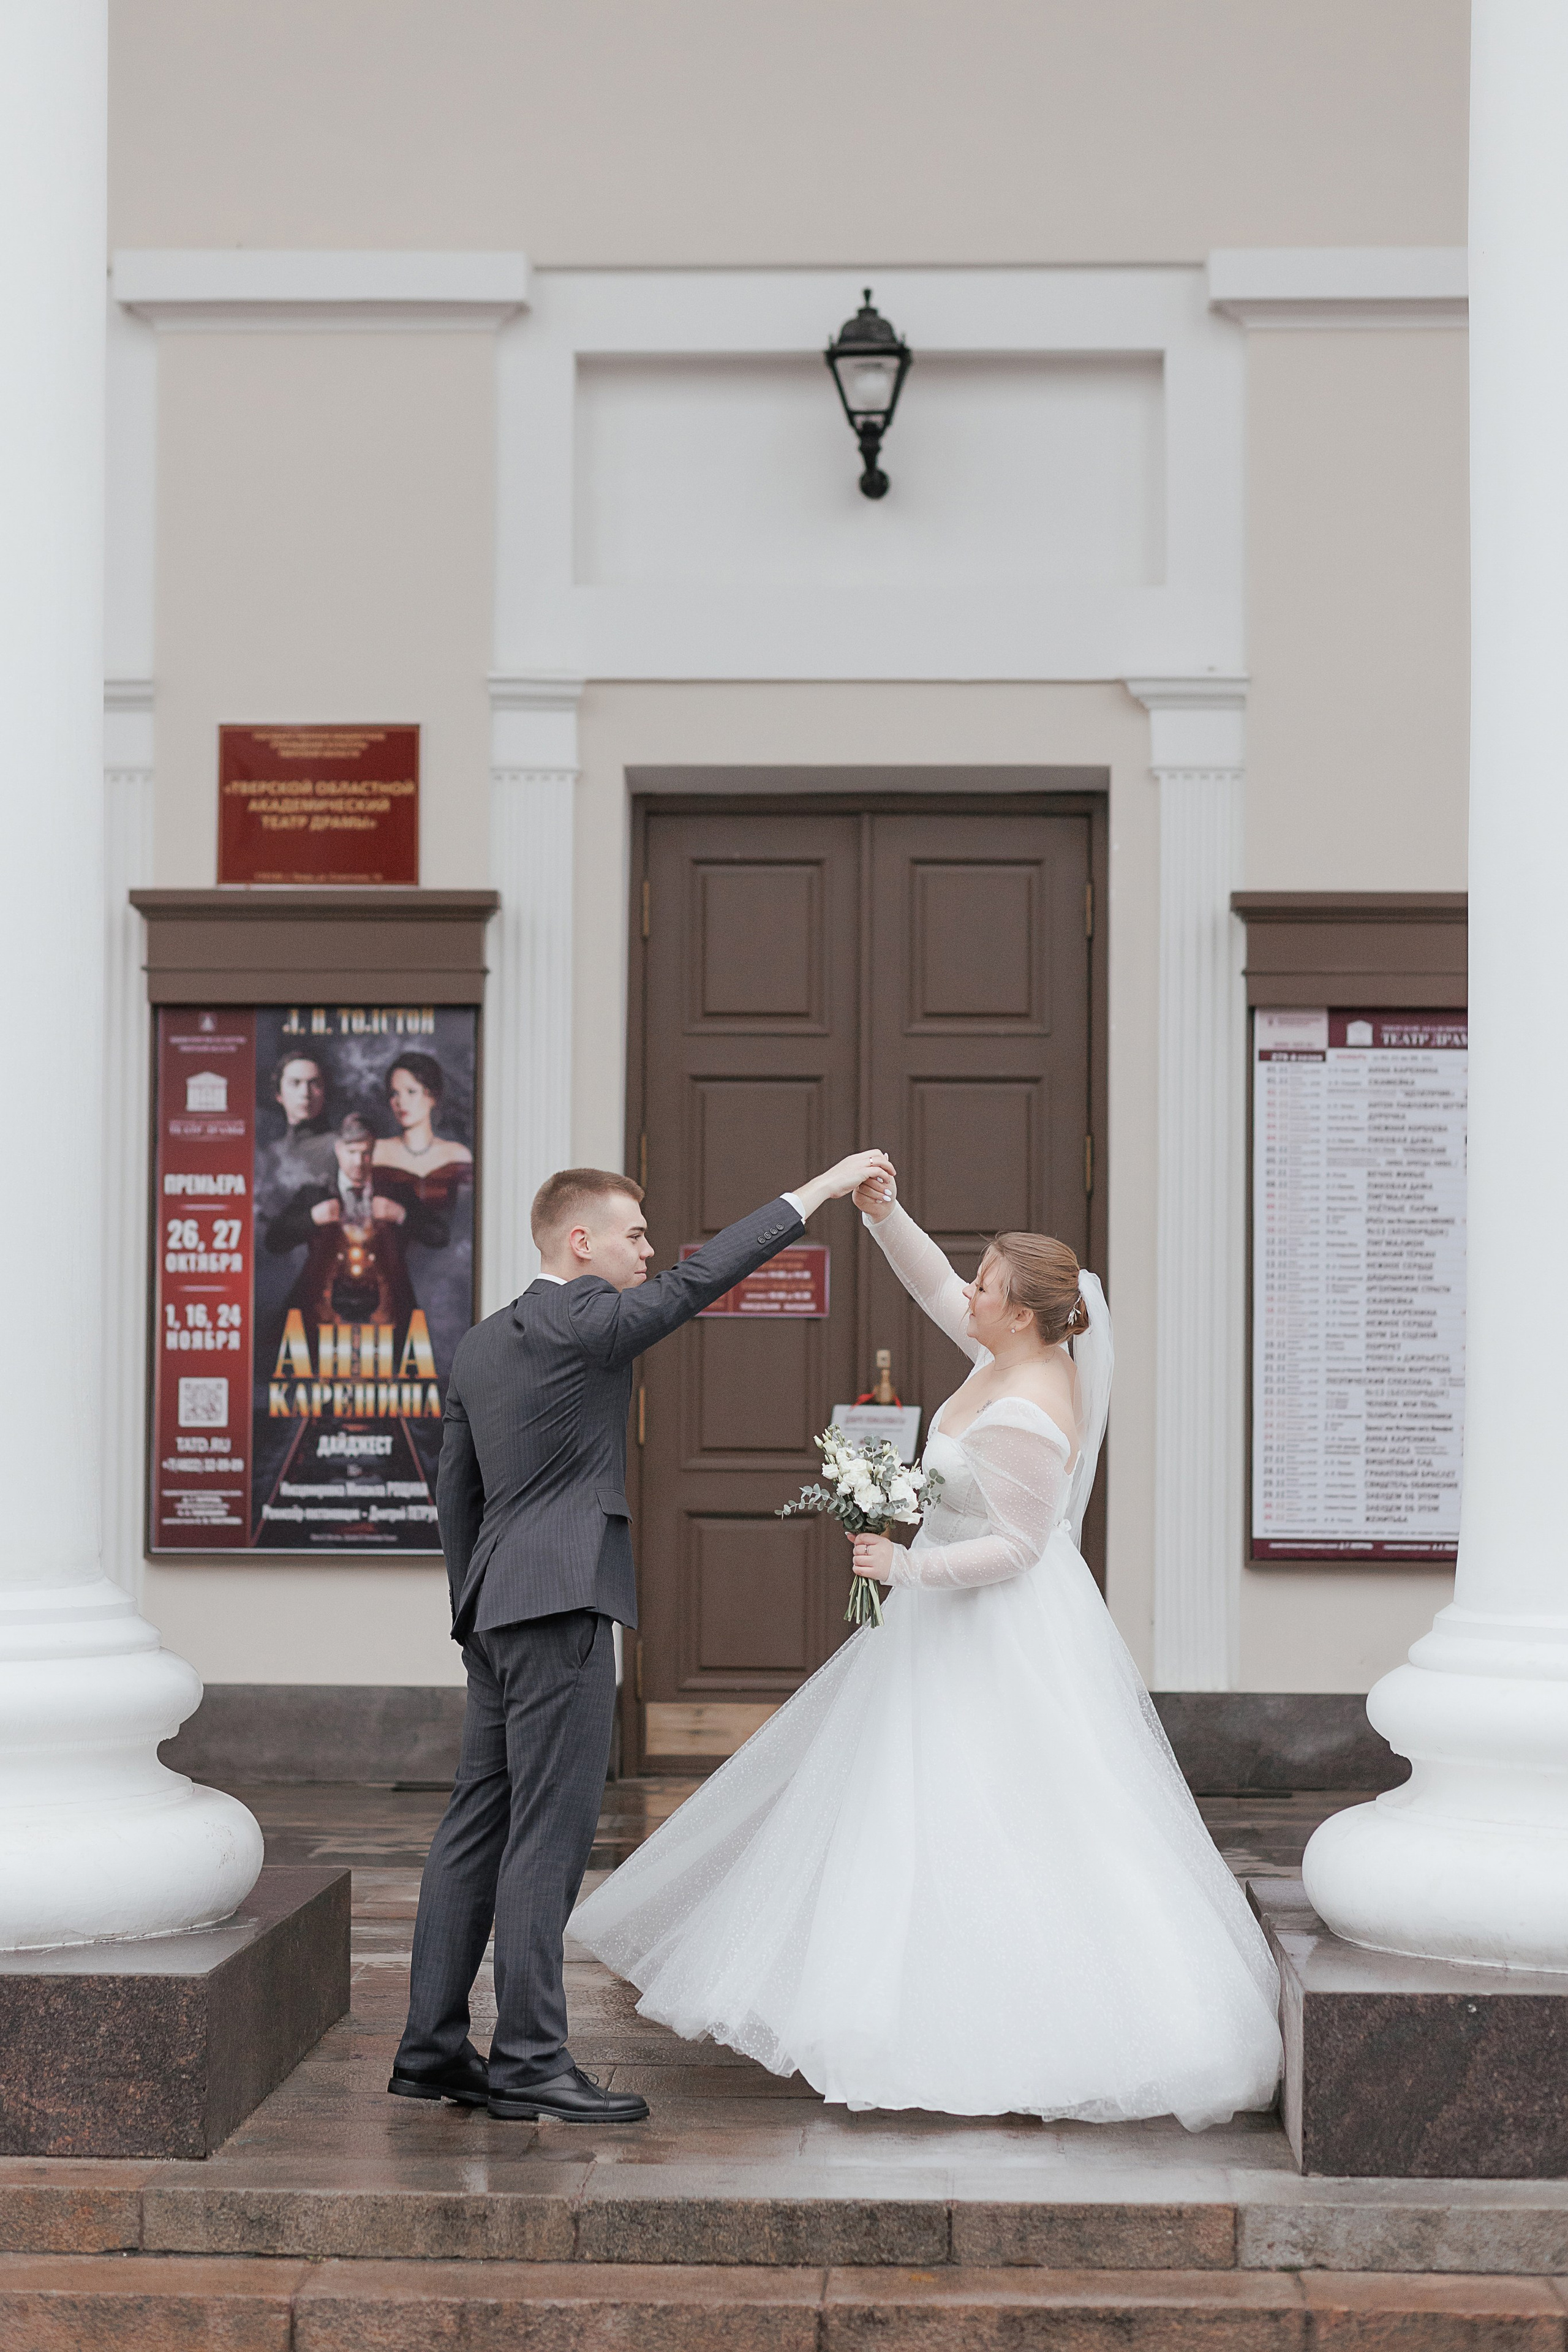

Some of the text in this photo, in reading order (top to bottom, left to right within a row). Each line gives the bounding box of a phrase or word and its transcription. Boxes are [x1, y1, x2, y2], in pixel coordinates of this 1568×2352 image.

[262, 815, 307, 829] ТЕАТР
[164, 1174, 246, 1195] ПРЕМЬЕРА
[167, 1218, 242, 1253] 26, 27
[165, 1253, 243, 1273] ОКТЯБРЯ
[165, 1303, 241, 1330] 1, 16, 24
[165, 1330, 241, 1351] НОЯБРЯ
[273, 1308, 439, 1379] АННА
[268, 1382, 442, 1418] КАРЕНИНА
[316, 1432, 394, 1458] ДАЙДЖЕСТ
